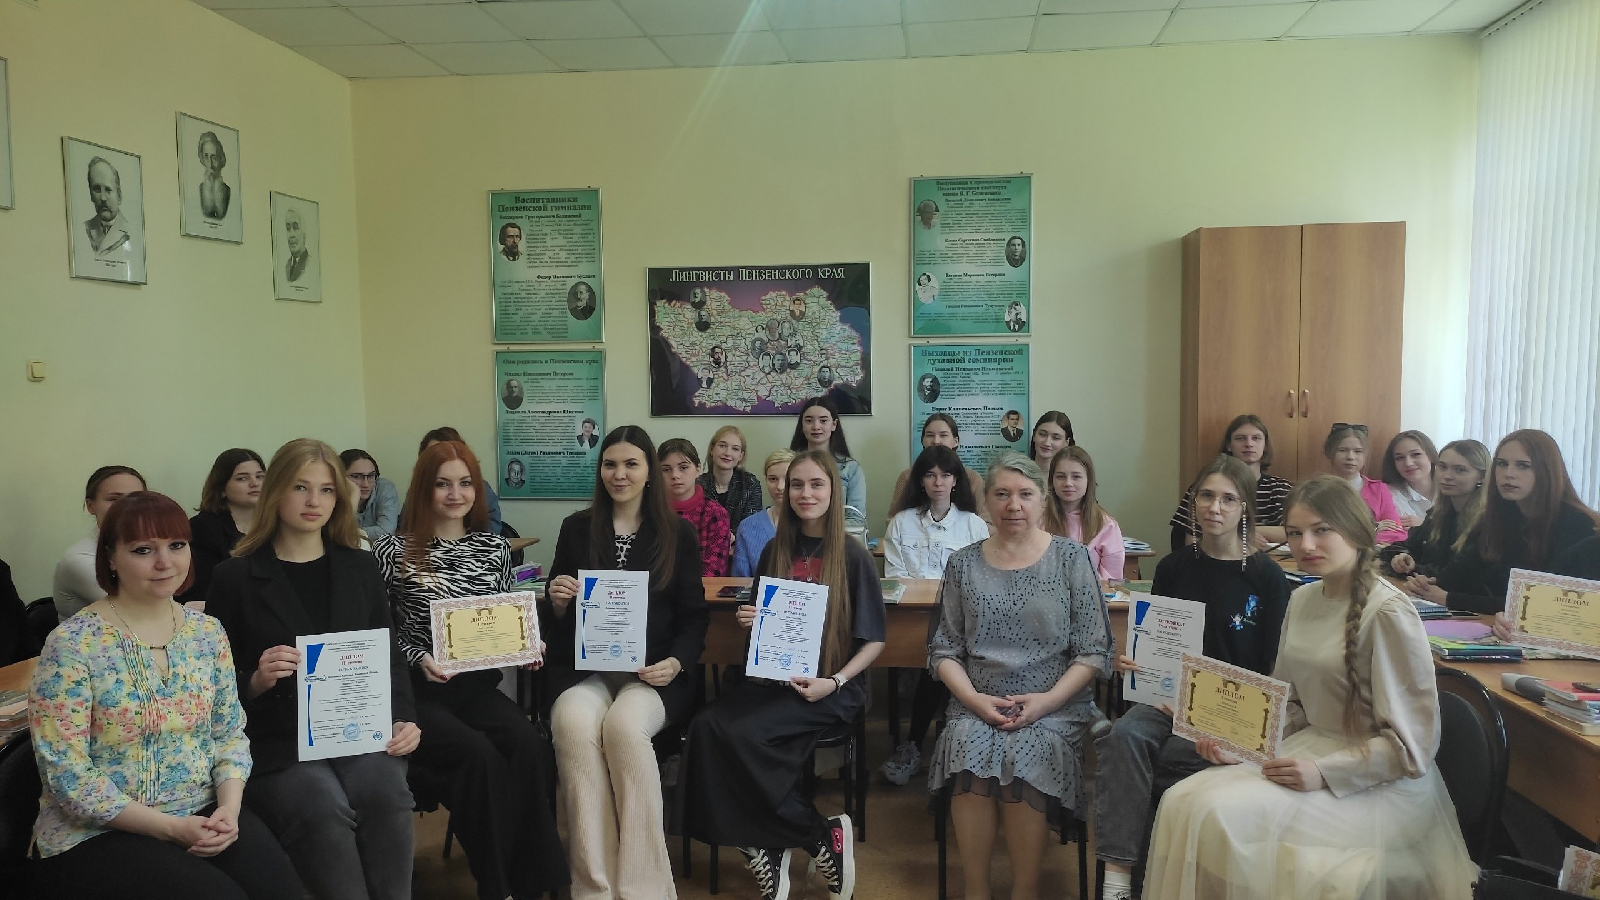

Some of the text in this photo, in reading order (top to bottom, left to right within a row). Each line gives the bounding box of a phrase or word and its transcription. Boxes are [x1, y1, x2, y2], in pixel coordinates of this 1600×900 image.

[514, 196, 578, 204] Воспитанники
[498, 204, 548, 212] Пензенской
[974, 348, 1023, 356] Пензенской
[927, 357, 1014, 365] духовной семинарии
